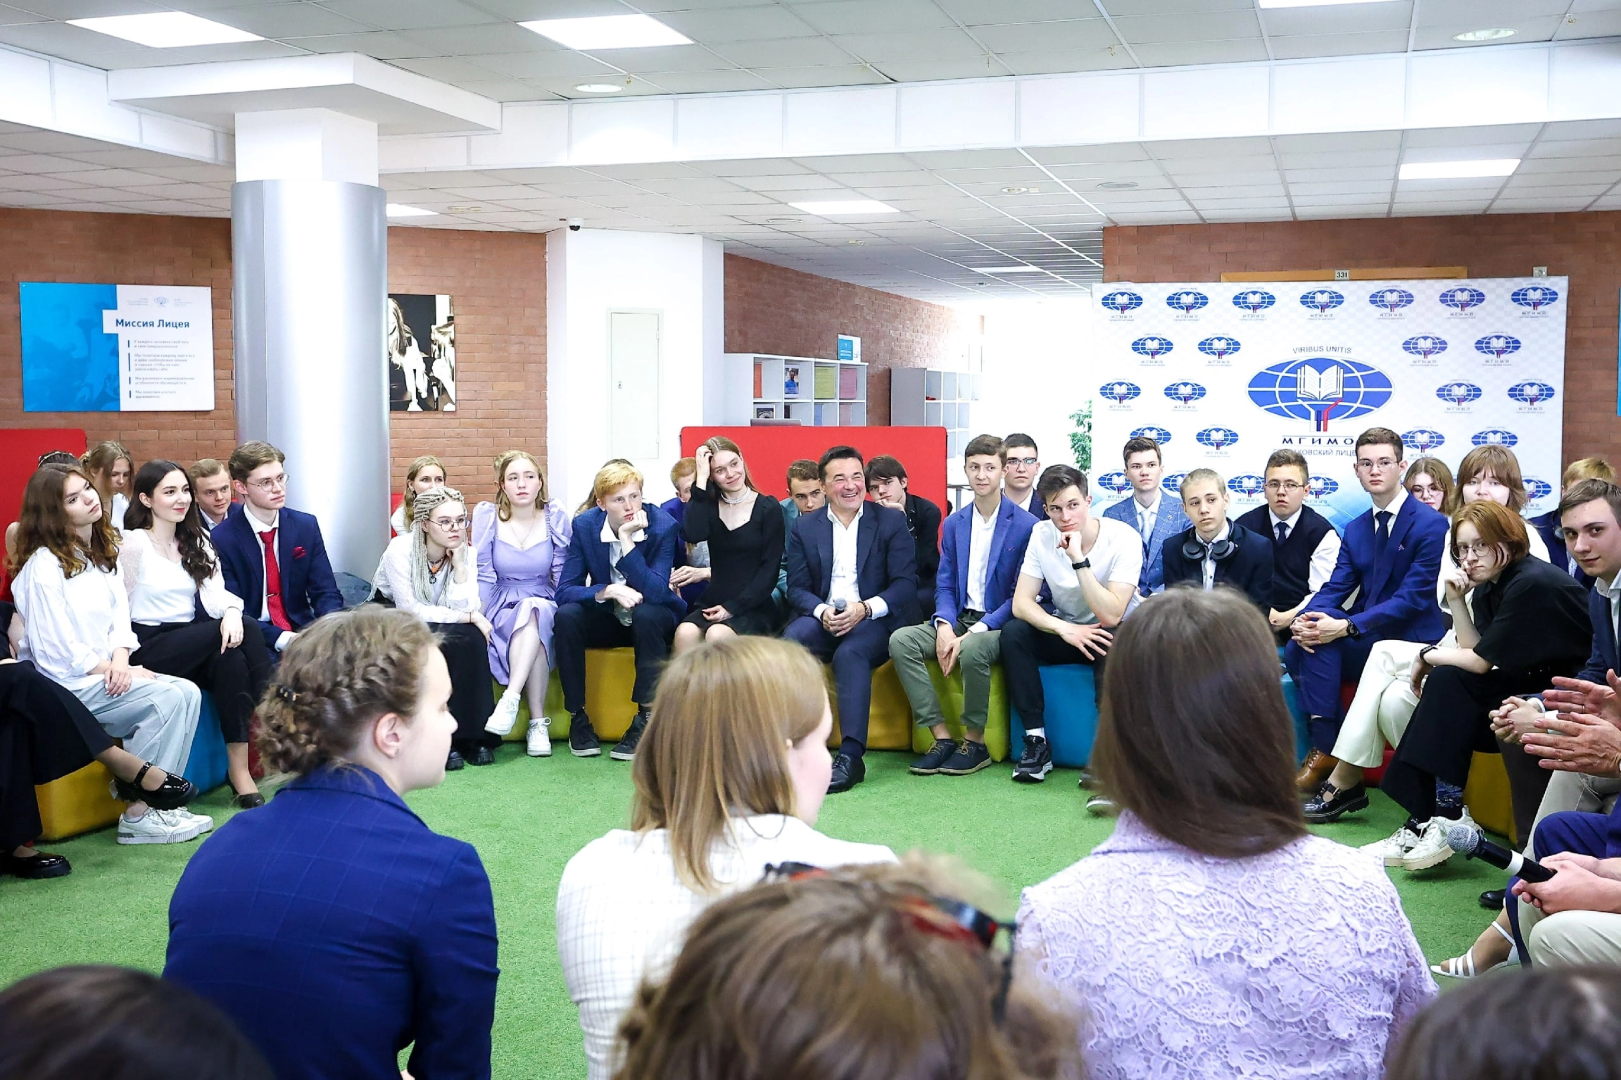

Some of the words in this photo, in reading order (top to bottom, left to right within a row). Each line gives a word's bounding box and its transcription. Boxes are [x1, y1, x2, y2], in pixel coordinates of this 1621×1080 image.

[115, 318, 155, 328] Миссия
[157, 319, 190, 329] Лицея
[1292, 346, 1324, 354] VIRIBUS
[1326, 346, 1352, 354] UNITIS
[1282, 437, 1354, 445] МГИМО
